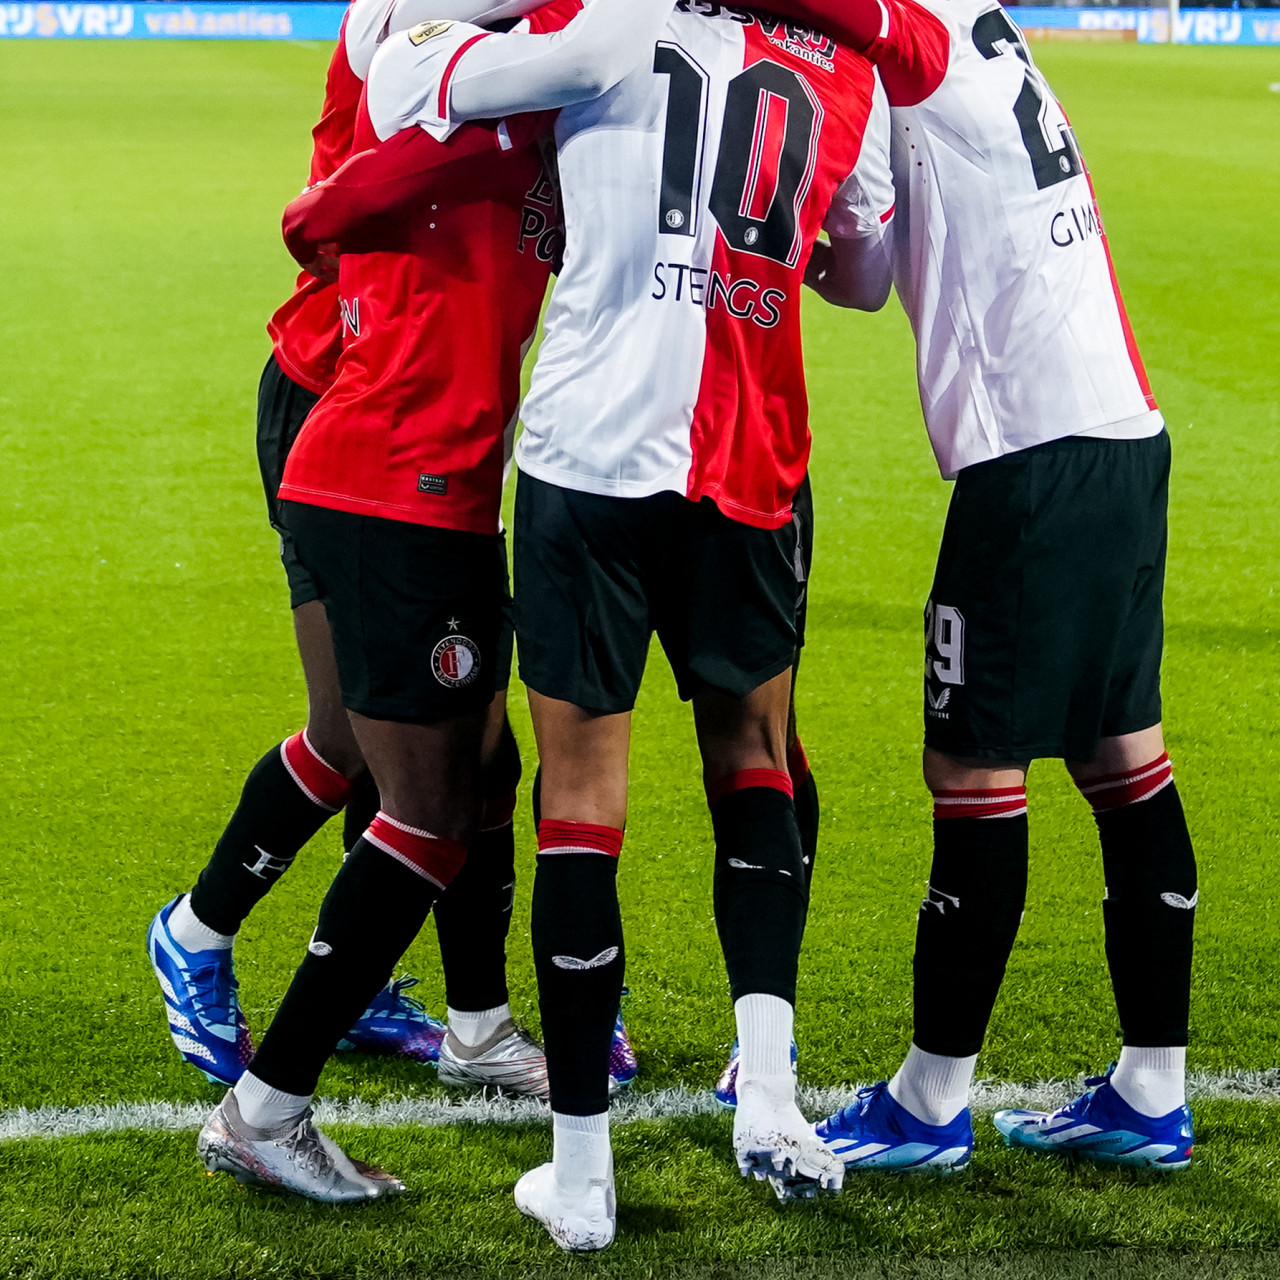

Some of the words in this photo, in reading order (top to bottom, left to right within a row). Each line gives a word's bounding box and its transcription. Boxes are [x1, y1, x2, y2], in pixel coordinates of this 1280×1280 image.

[144, 6, 294, 36] vakanties
[652, 40, 825, 270] 10
[651, 261, 787, 329] STENGS
